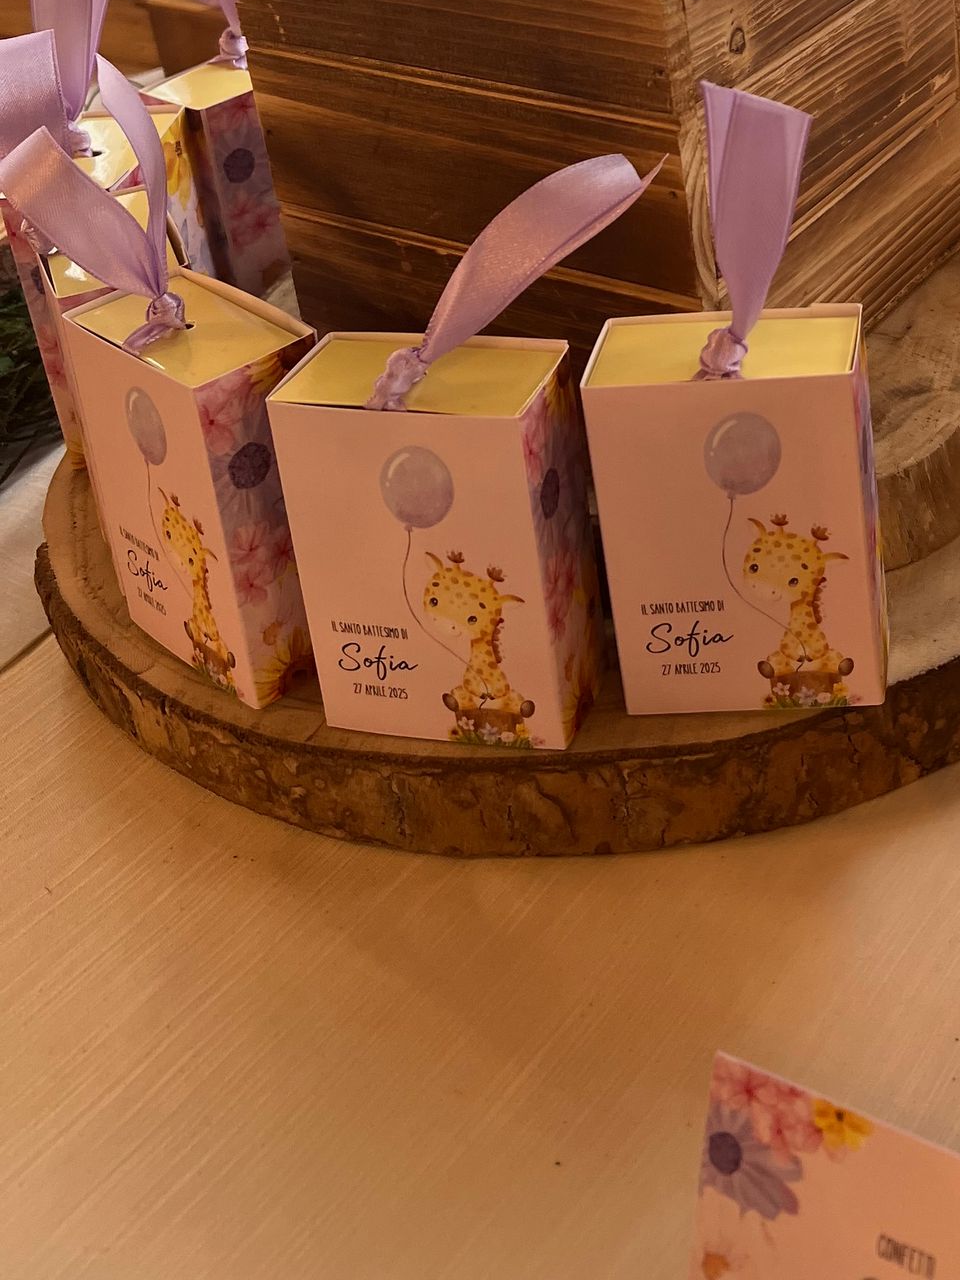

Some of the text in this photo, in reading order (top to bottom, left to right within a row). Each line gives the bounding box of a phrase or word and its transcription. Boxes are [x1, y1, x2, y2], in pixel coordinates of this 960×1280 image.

[127, 549, 168, 592] Sofia
[641, 599, 725, 615] IL SANTO BATTESIMO DI
[339, 621, 361, 635] SANTO
[363, 624, 400, 639] BATTESIMO
[401, 628, 409, 640] DI
[646, 620, 734, 657] Sofia
[338, 642, 418, 680] Sofia
[661, 662, 721, 676] 27 APRILE 2025
[353, 683, 362, 695] 27
[388, 687, 409, 700] 2025
